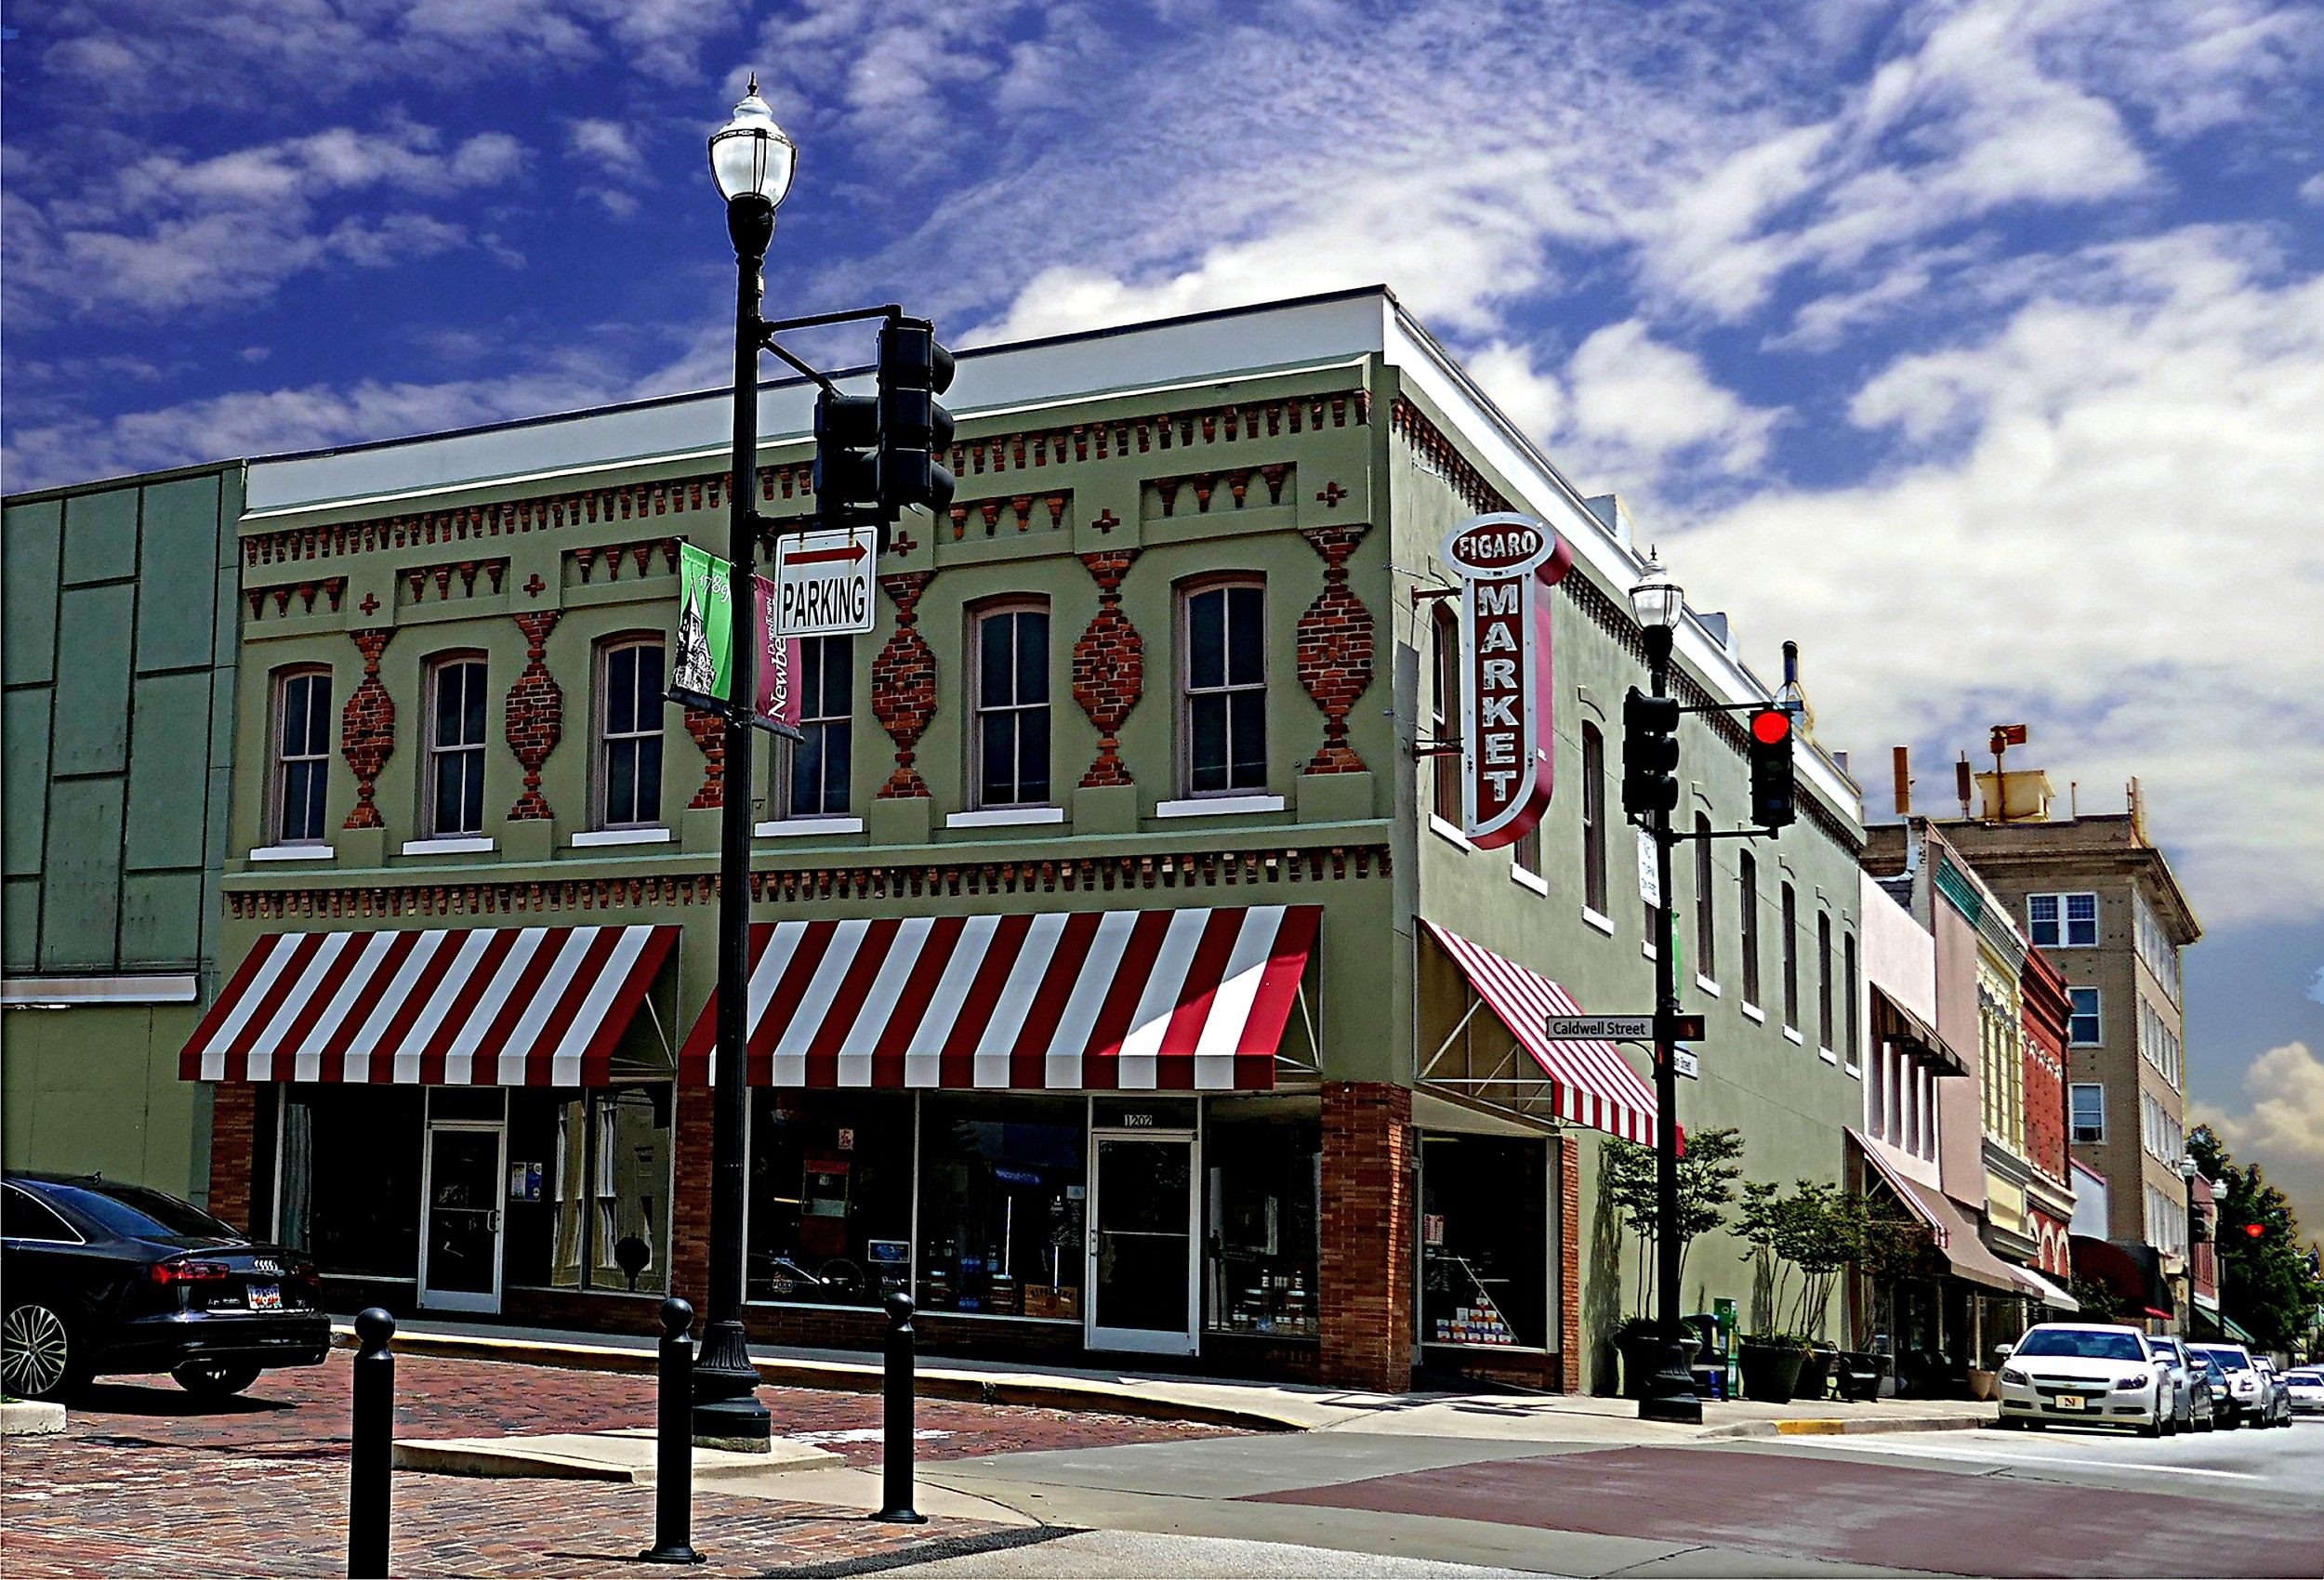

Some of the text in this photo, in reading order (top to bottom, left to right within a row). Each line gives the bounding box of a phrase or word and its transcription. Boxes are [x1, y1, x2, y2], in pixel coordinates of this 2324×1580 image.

[1459, 531, 1537, 560] FIGARO
[699, 573, 731, 603] 1789
[783, 575, 865, 628] PARKING
[768, 638, 787, 721] Newbe
[1478, 584, 1520, 802] MARKET
[1552, 1020, 1645, 1035] Caldwell Street
[1125, 1114, 1153, 1126] 1202
